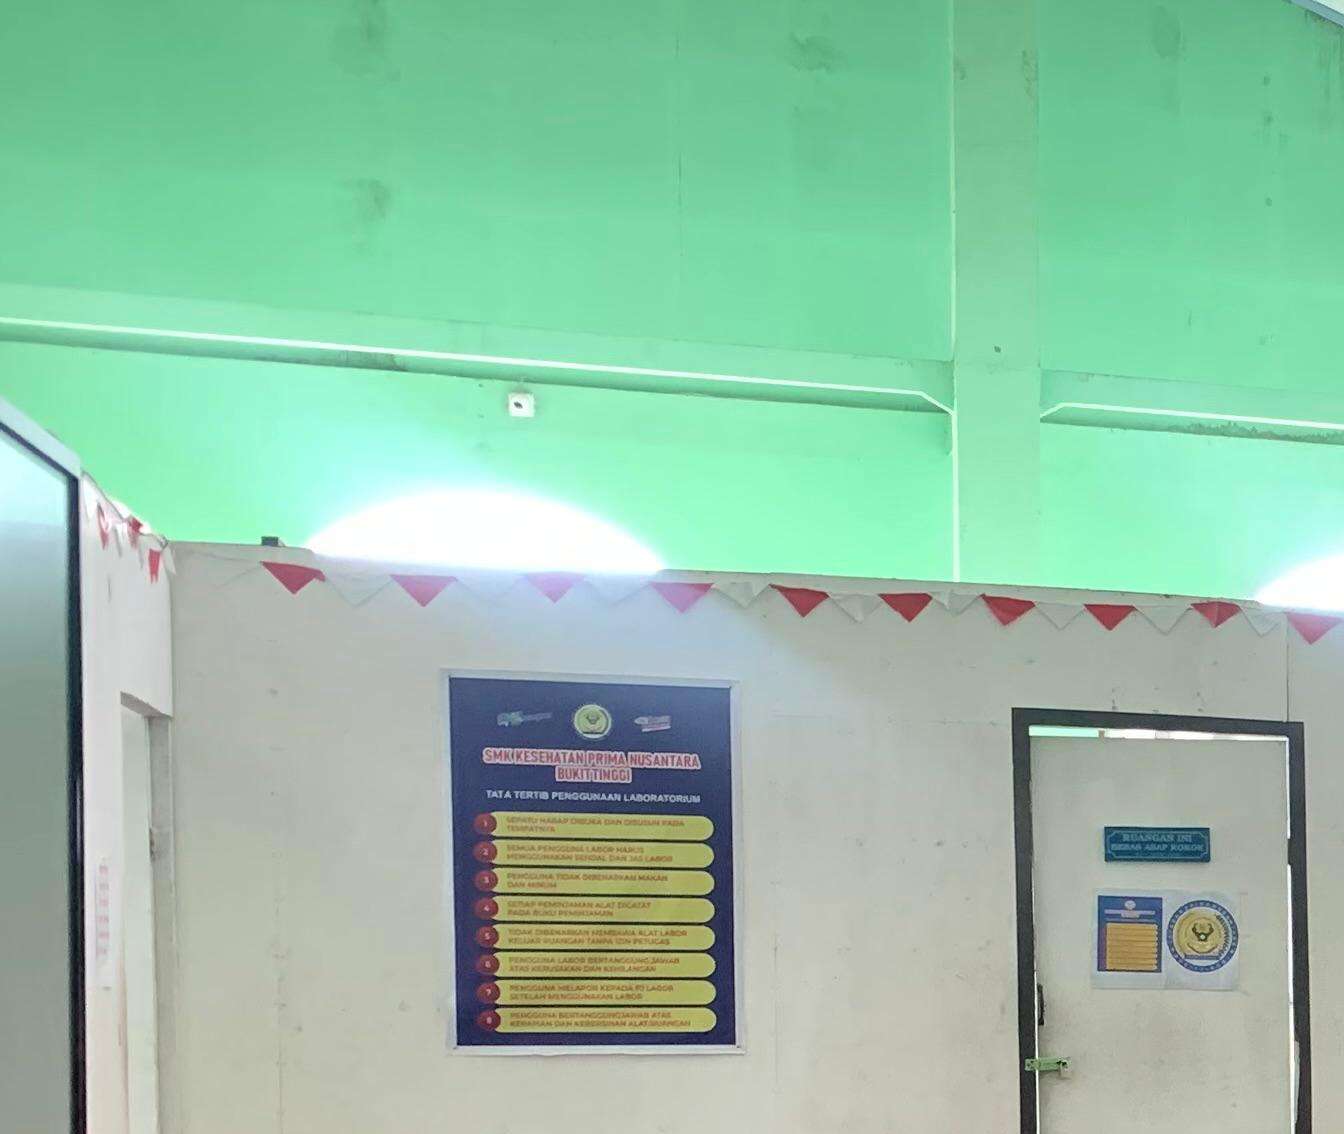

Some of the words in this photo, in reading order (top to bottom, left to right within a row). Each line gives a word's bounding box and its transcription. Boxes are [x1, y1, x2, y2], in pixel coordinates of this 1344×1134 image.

[484, 749, 512, 763] SMK
[513, 750, 584, 766] KESEHATAN
[588, 752, 627, 767] PRIMA
[630, 753, 700, 769] NUSANTARA
[557, 767, 631, 782] BUKITTINGGI
[486, 789, 511, 799] TATA
[514, 790, 549, 800] TERTIB
[551, 791, 621, 802] PENGGUNAAN
[623, 793, 700, 804] LABORATORIUM
